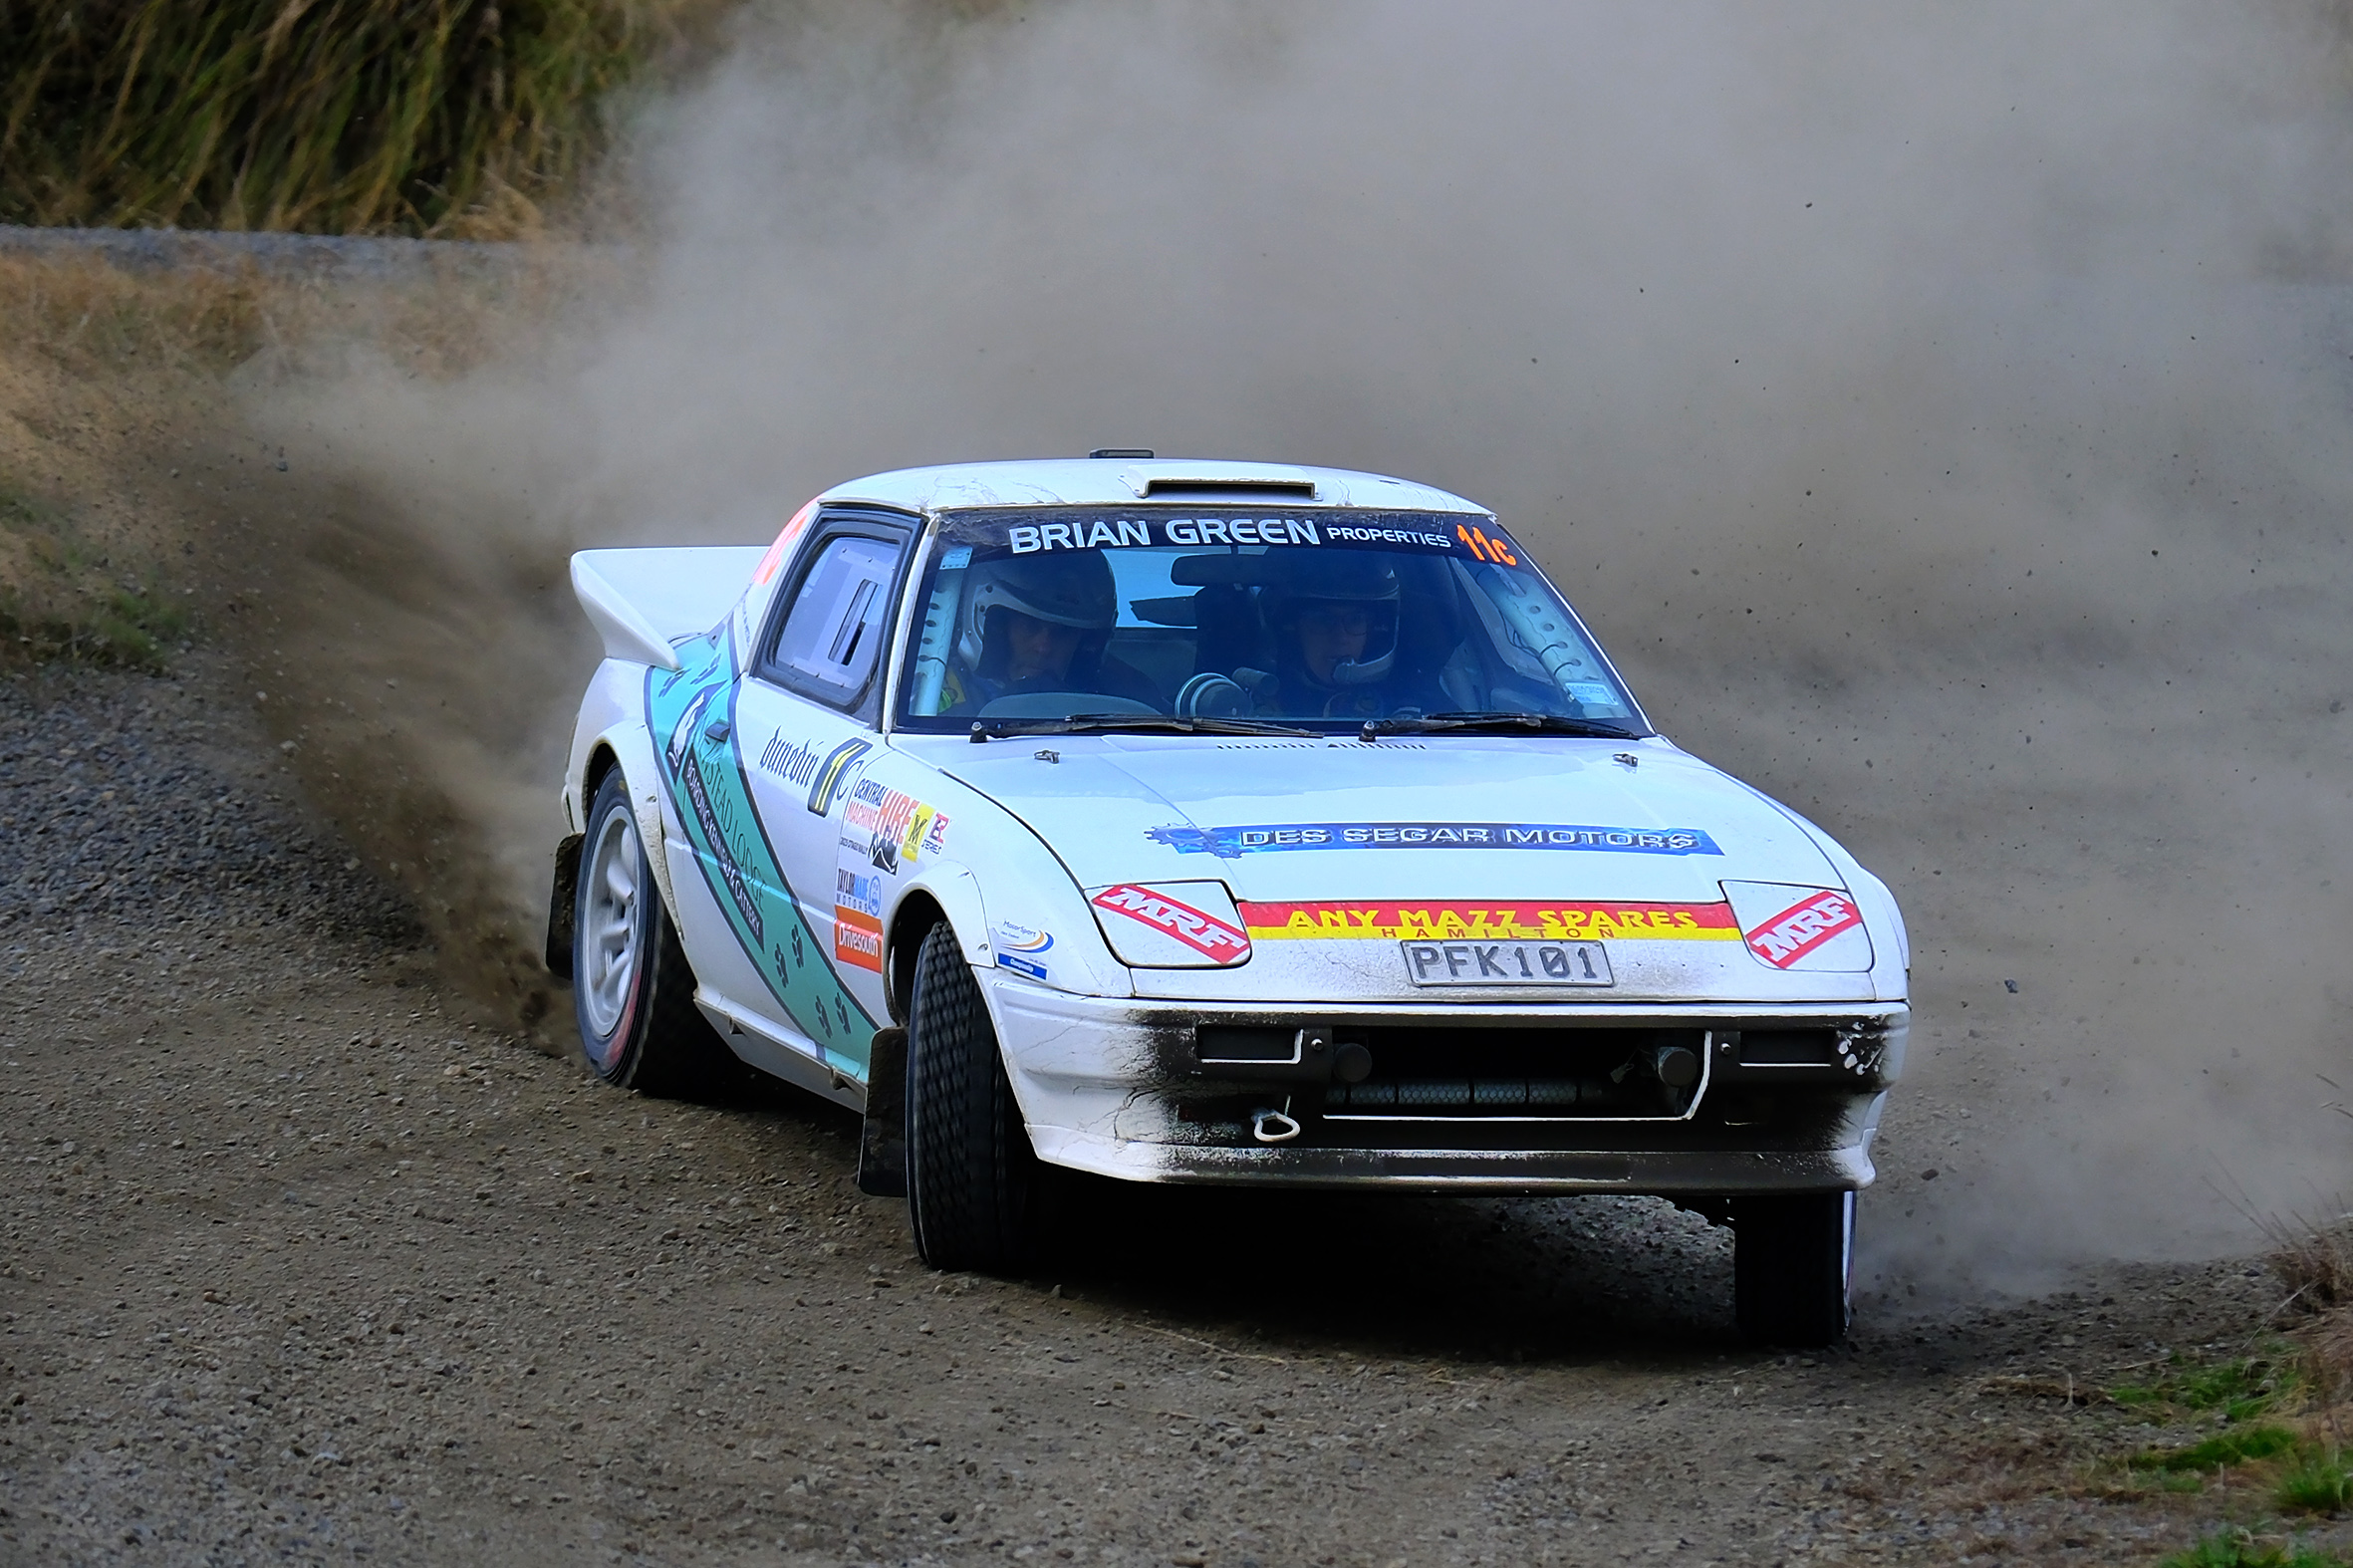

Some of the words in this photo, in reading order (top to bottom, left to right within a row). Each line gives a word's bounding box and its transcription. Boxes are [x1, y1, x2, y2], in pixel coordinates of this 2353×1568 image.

[1008, 520, 1151, 554] BRIAN
[1166, 518, 1321, 545] GREEN
[1327, 527, 1451, 548] PROPERTIES
[759, 725, 824, 788] dunedin
[855, 778, 889, 807] CENTRAL
[846, 800, 878, 832] MACHINE
[874, 789, 919, 845] HIRE
[687, 758, 710, 830] BOARDING
[734, 880, 760, 936] CATTERY
[1241, 830, 1327, 846] DES
[1342, 828, 1490, 844] SEGAR
[1504, 828, 1696, 849] MOTORS
[731, 819, 768, 912] LODGE
[836, 893, 868, 914] MOTORS
[1100, 887, 1247, 948] MRF
[1285, 910, 1379, 931] ANY
[1397, 909, 1518, 931] MAZZ
[1537, 911, 1699, 929] SPARES
[838, 922, 879, 957] Drivesouth
[1381, 927, 1615, 939] HAMILTON
[1751, 896, 1851, 962] MRF
[1409, 945, 1598, 979] PFK101
